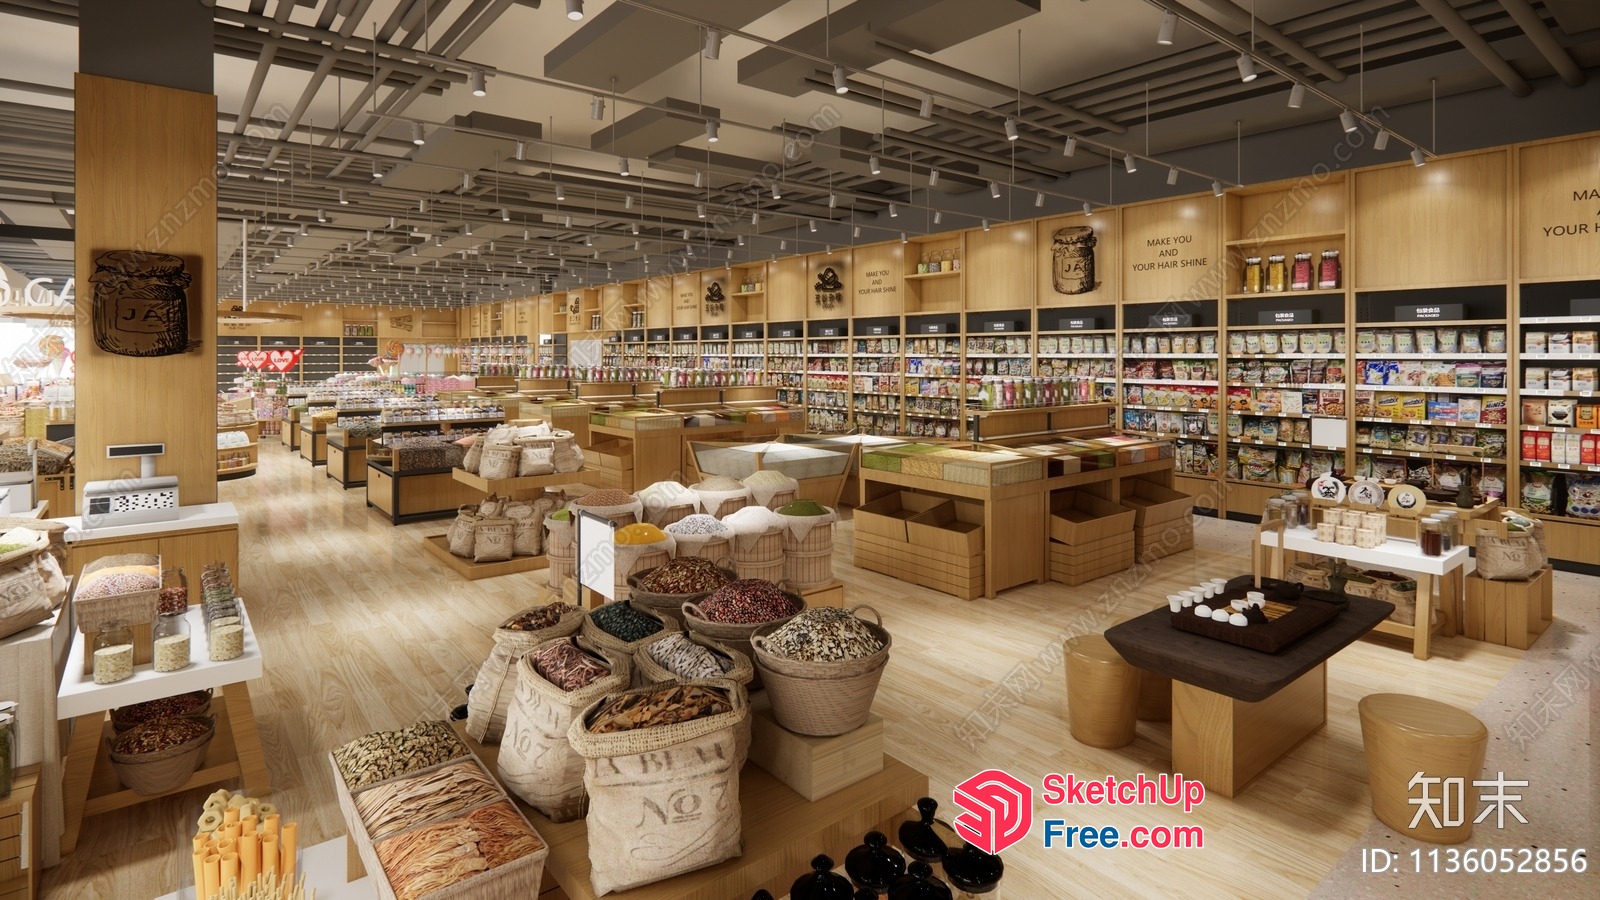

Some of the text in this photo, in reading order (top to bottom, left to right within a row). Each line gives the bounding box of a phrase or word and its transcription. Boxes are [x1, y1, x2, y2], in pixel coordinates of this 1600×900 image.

[1543, 223, 1589, 237] YOUR
[1146, 234, 1192, 247] MAKE YOU
[1158, 248, 1179, 258] AND
[1132, 257, 1208, 272] YOUR HAIR SHINE
[866, 270, 878, 278] MAKE
